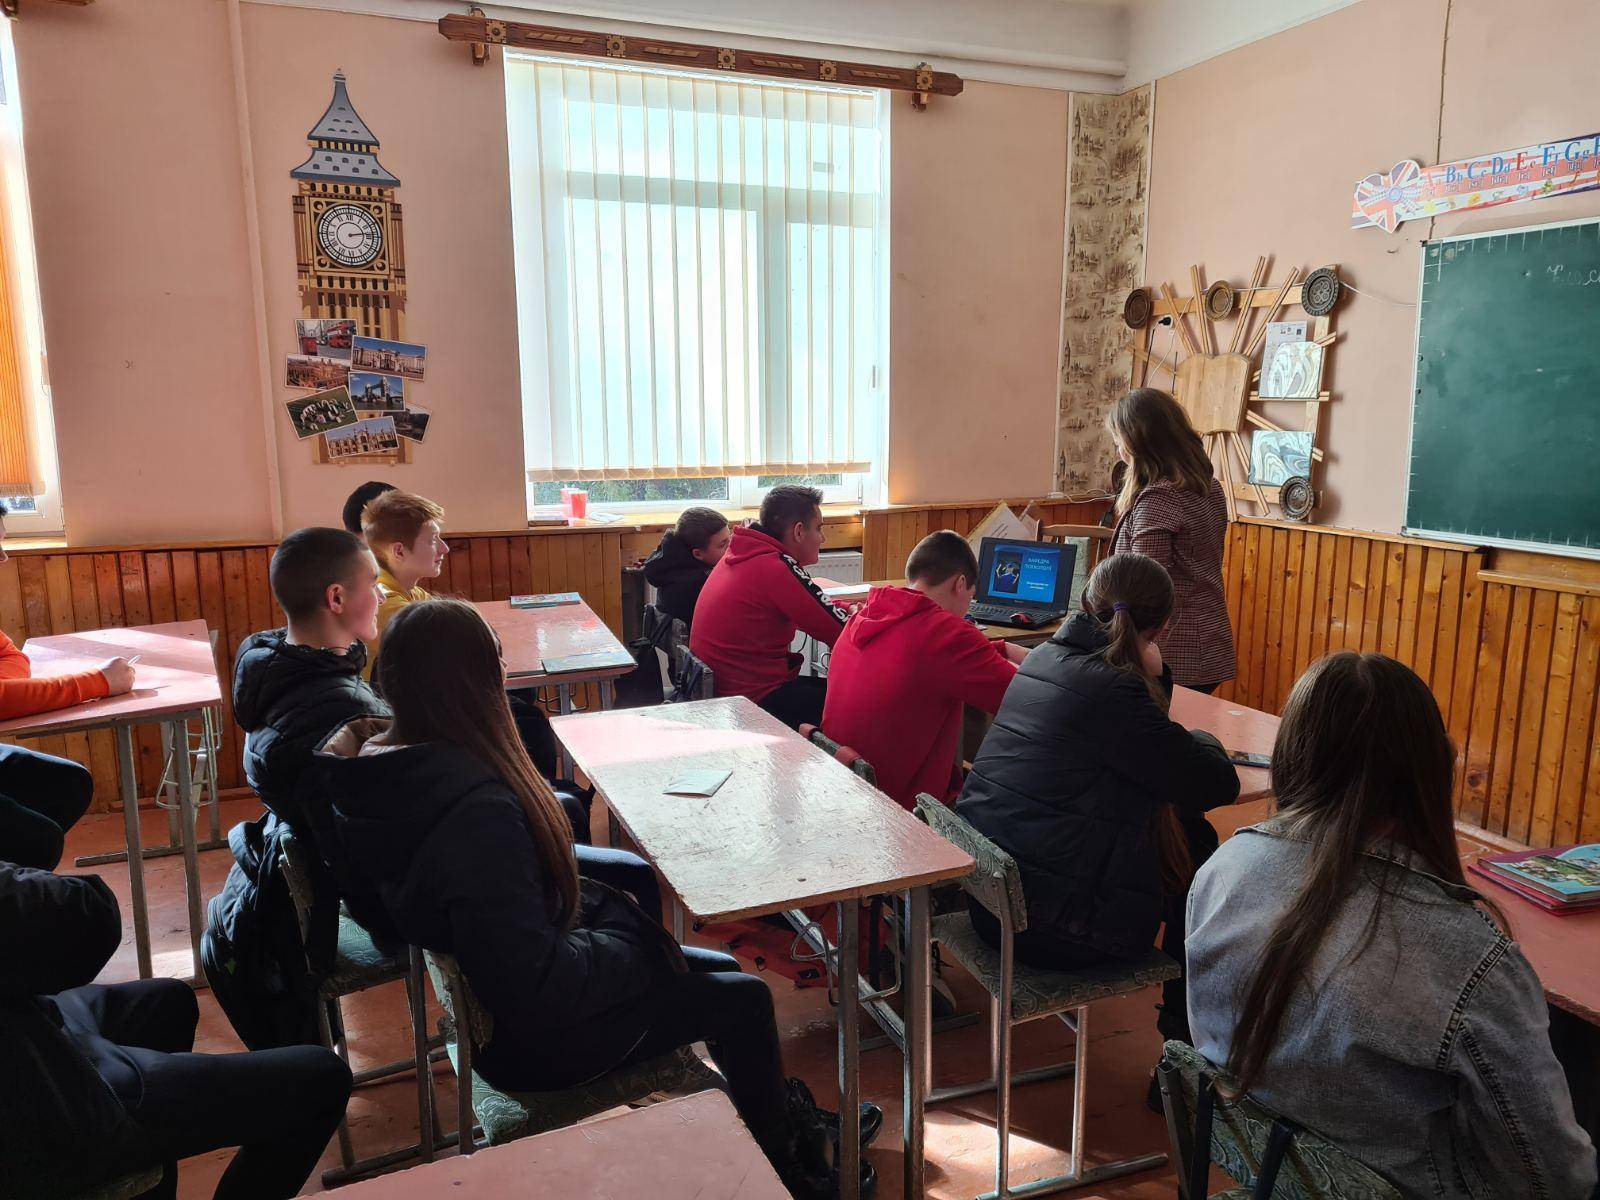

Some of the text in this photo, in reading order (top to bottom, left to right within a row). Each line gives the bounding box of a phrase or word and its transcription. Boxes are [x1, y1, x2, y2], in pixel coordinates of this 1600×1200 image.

[1446, 165, 1463, 183] Bb
[1468, 160, 1487, 180] Cc
[1492, 156, 1511, 175] Dd
[1516, 151, 1536, 170] Ee
[1565, 141, 1590, 161] Gg
